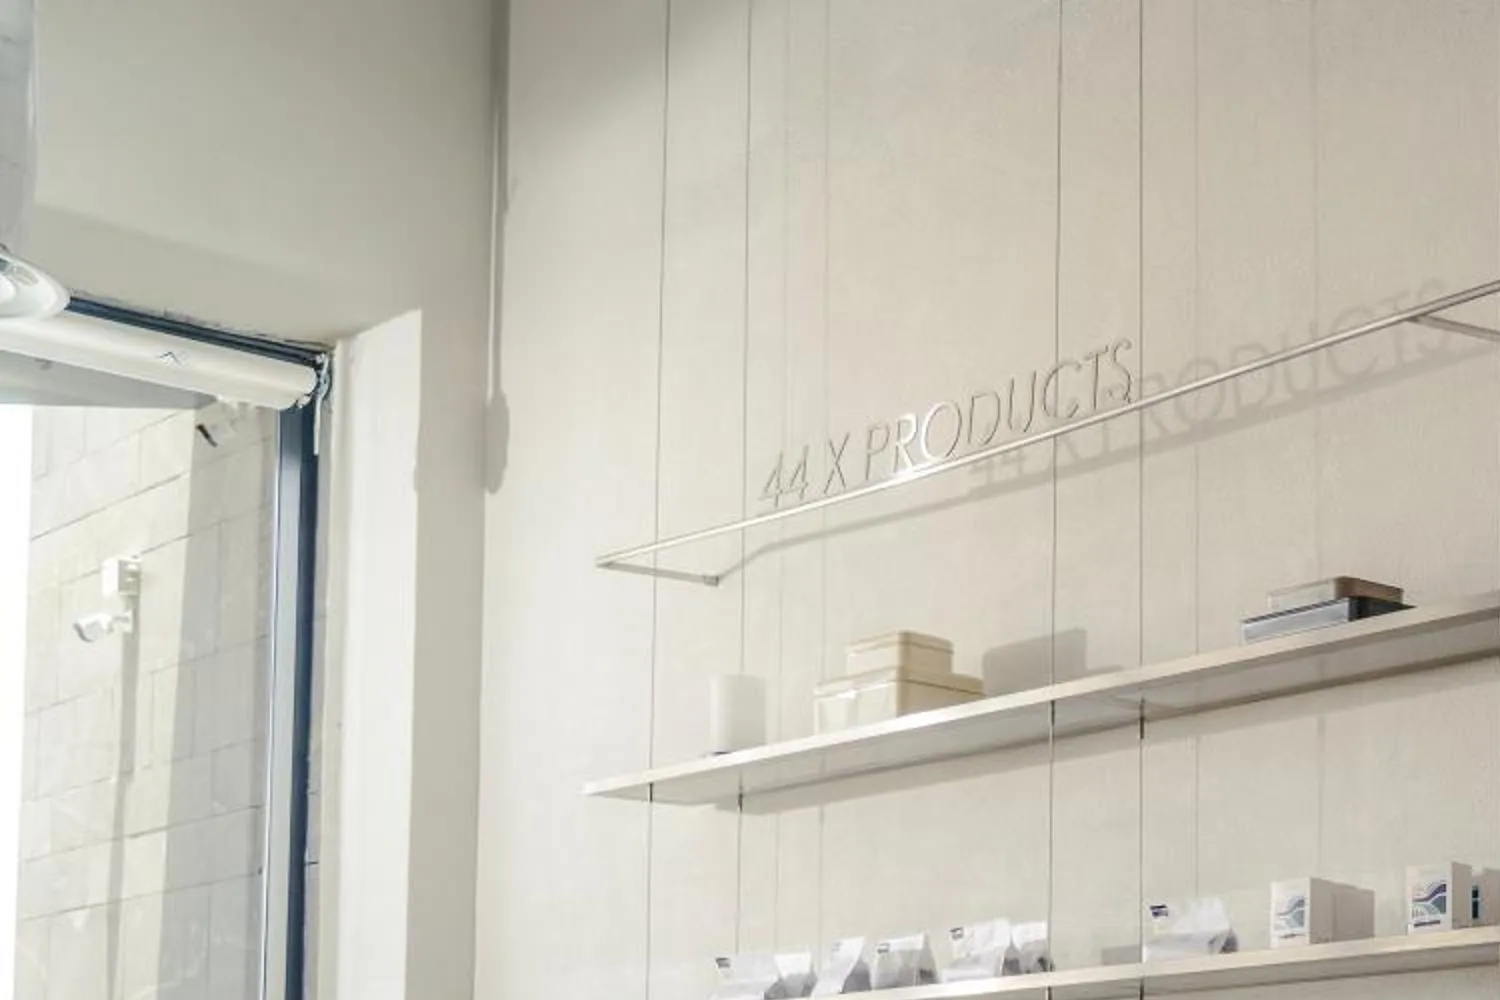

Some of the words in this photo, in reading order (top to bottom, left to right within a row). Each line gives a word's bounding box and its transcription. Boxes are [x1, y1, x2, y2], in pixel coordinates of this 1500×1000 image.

[762, 444, 810, 507] 44
[824, 432, 850, 495] X
[864, 338, 1134, 482] PRODUCTS
